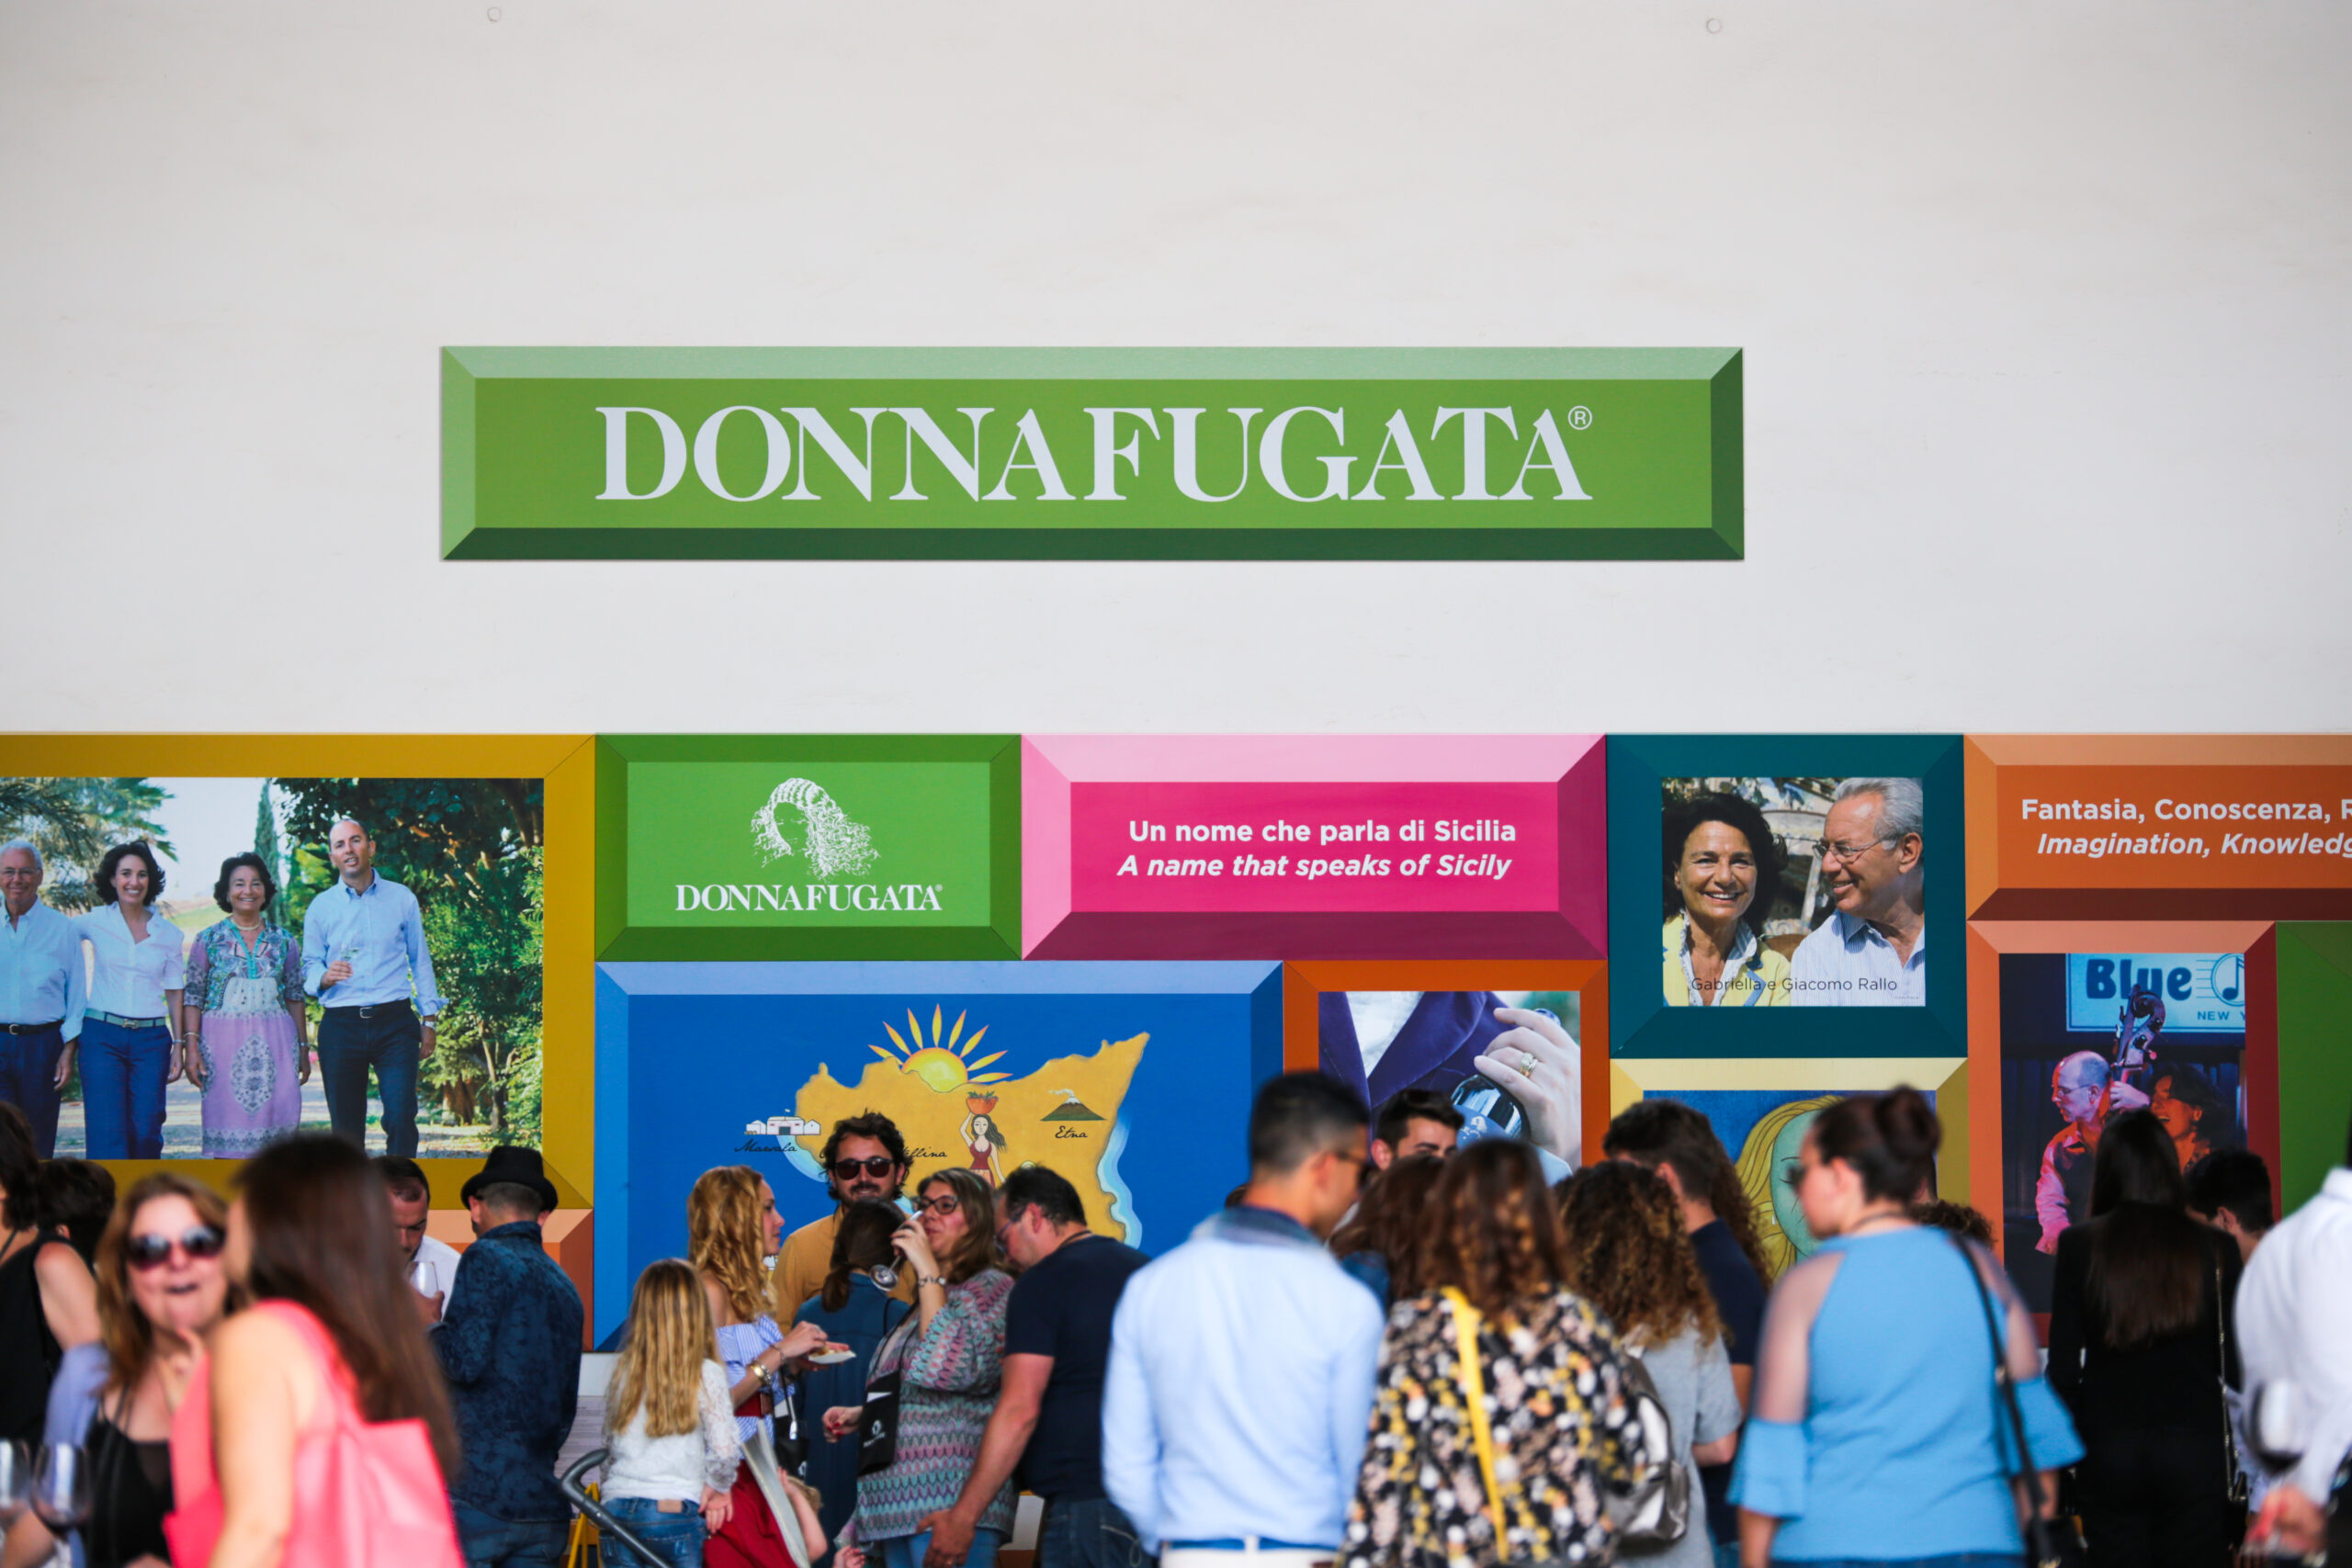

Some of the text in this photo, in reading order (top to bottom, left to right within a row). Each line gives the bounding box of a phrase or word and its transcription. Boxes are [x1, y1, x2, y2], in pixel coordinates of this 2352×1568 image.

[2021, 797, 2146, 824] Fantasia,
[2154, 797, 2332, 824] Conoscenza,
[1129, 819, 1516, 846] Un nome che parla di Sicilia
[2037, 831, 2211, 859] Imagination,
[1115, 853, 1512, 880] A name that speaks of Sicily
[1690, 976, 1898, 991] Gabriella e Giacomo Rallo
[2086, 958, 2193, 1001] Blue
[2197, 1010, 2231, 1021] NEW
[1054, 1125, 1089, 1139] Etna
